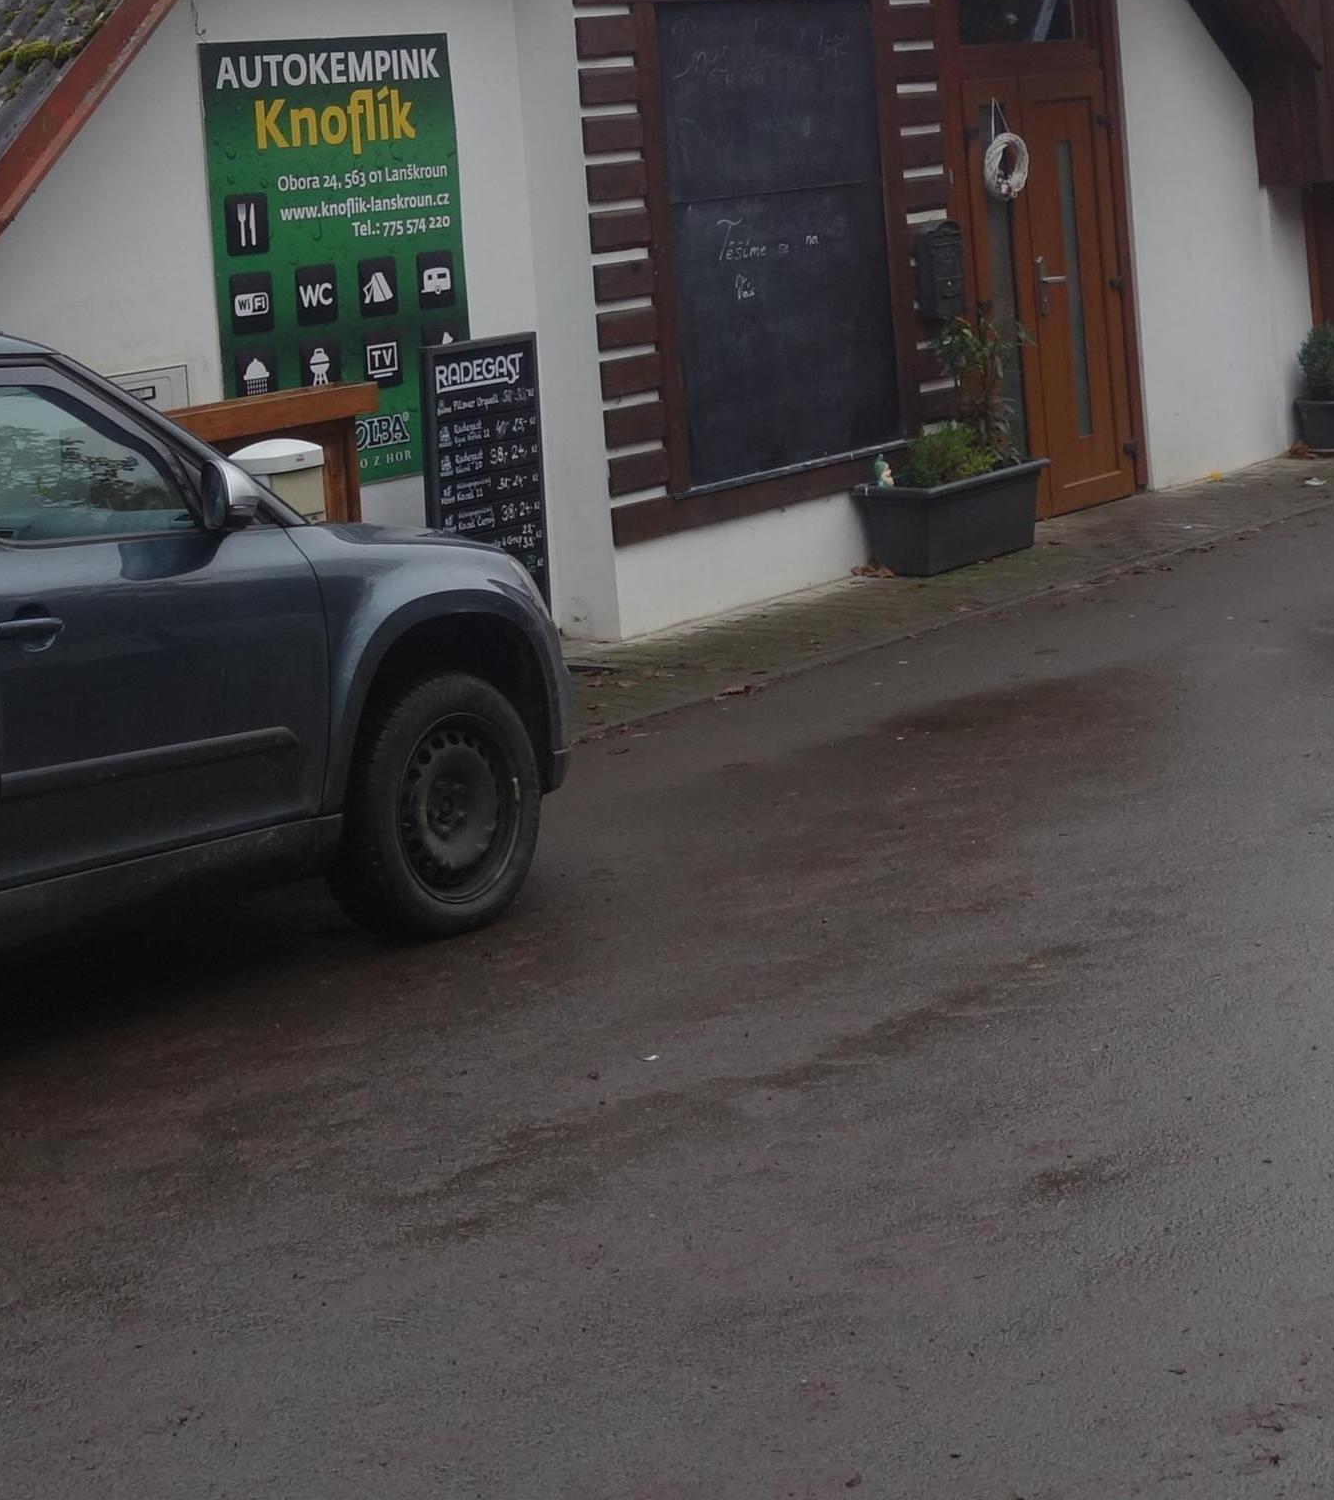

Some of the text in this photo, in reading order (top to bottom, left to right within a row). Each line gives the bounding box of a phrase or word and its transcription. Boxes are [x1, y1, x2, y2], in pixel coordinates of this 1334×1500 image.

[216, 48, 440, 90] AUTOKEMPINK
[254, 86, 416, 155] Knoflík
[278, 163, 448, 192] Obora 24, 563 01 Lanškroun
[280, 191, 450, 221] www.knoflik-lanskroun.cz
[352, 216, 450, 237] Tel.: 775 574 220
[299, 282, 333, 308] WC
[371, 350, 393, 366] TV
[435, 352, 523, 394] RADEGAST
[386, 450, 412, 464] HOR
